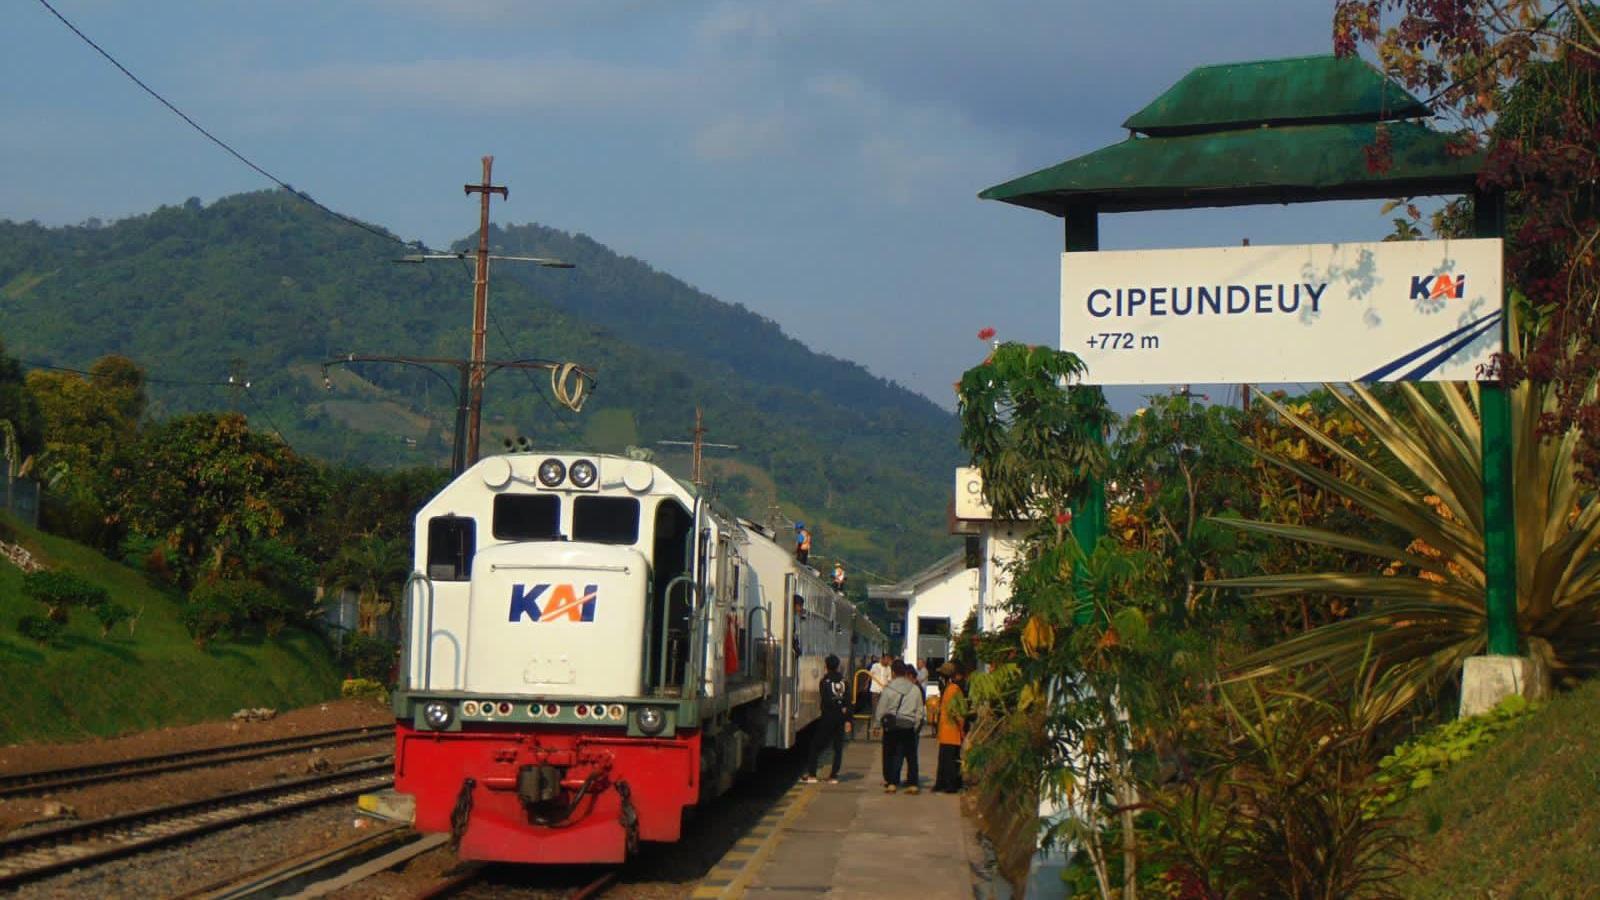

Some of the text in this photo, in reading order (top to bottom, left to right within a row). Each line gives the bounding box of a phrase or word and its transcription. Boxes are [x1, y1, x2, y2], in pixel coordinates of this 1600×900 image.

[1087, 282, 1328, 318] CIPEUNDEUY
[1086, 332, 1160, 350] +772 m
